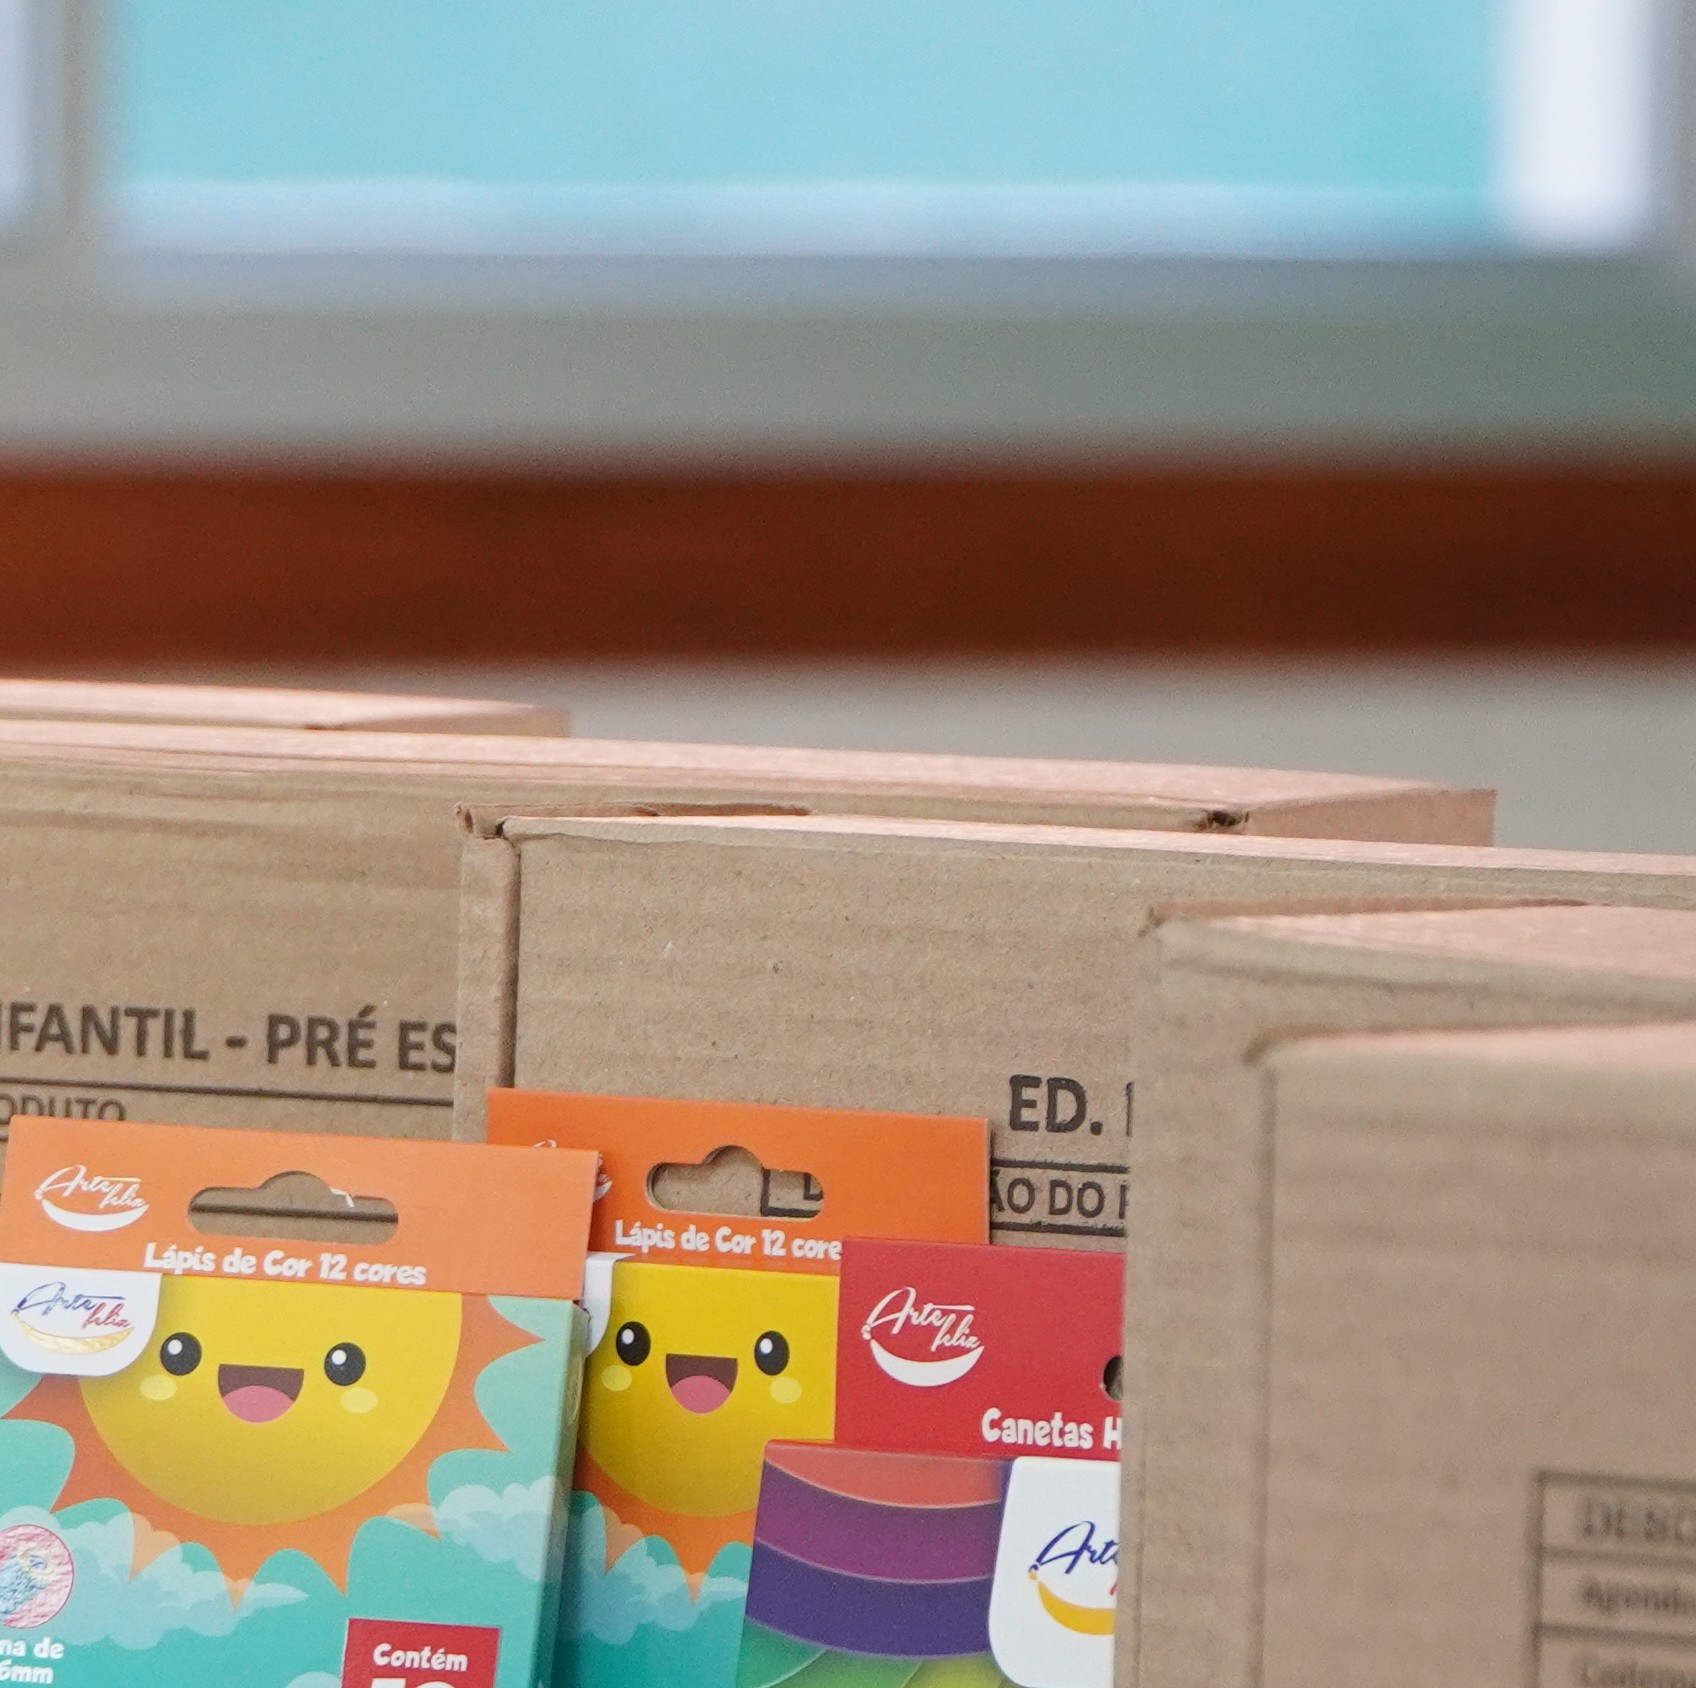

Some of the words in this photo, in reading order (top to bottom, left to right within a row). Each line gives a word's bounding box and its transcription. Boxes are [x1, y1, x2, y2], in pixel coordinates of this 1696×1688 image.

[265, 1006, 376, 1071] PRÉ
[1009, 1074, 1104, 1136] ED.
[1048, 1179, 1105, 1218] DO
[614, 1219, 676, 1250] Lápis
[680, 1223, 710, 1252] de
[714, 1227, 757, 1256] Cor
[762, 1229, 787, 1258] 12
[143, 1240, 219, 1278] Lápis
[222, 1246, 258, 1276] de
[262, 1253, 314, 1281] Cor
[319, 1253, 351, 1283] 12
[355, 1261, 428, 1287] cores
[861, 1286, 976, 1340] Arte
[930, 1313, 982, 1352] feliz
[980, 1407, 1094, 1450] Canetas
[32, 1636, 66, 1662] de
[372, 1642, 470, 1675] Contém
